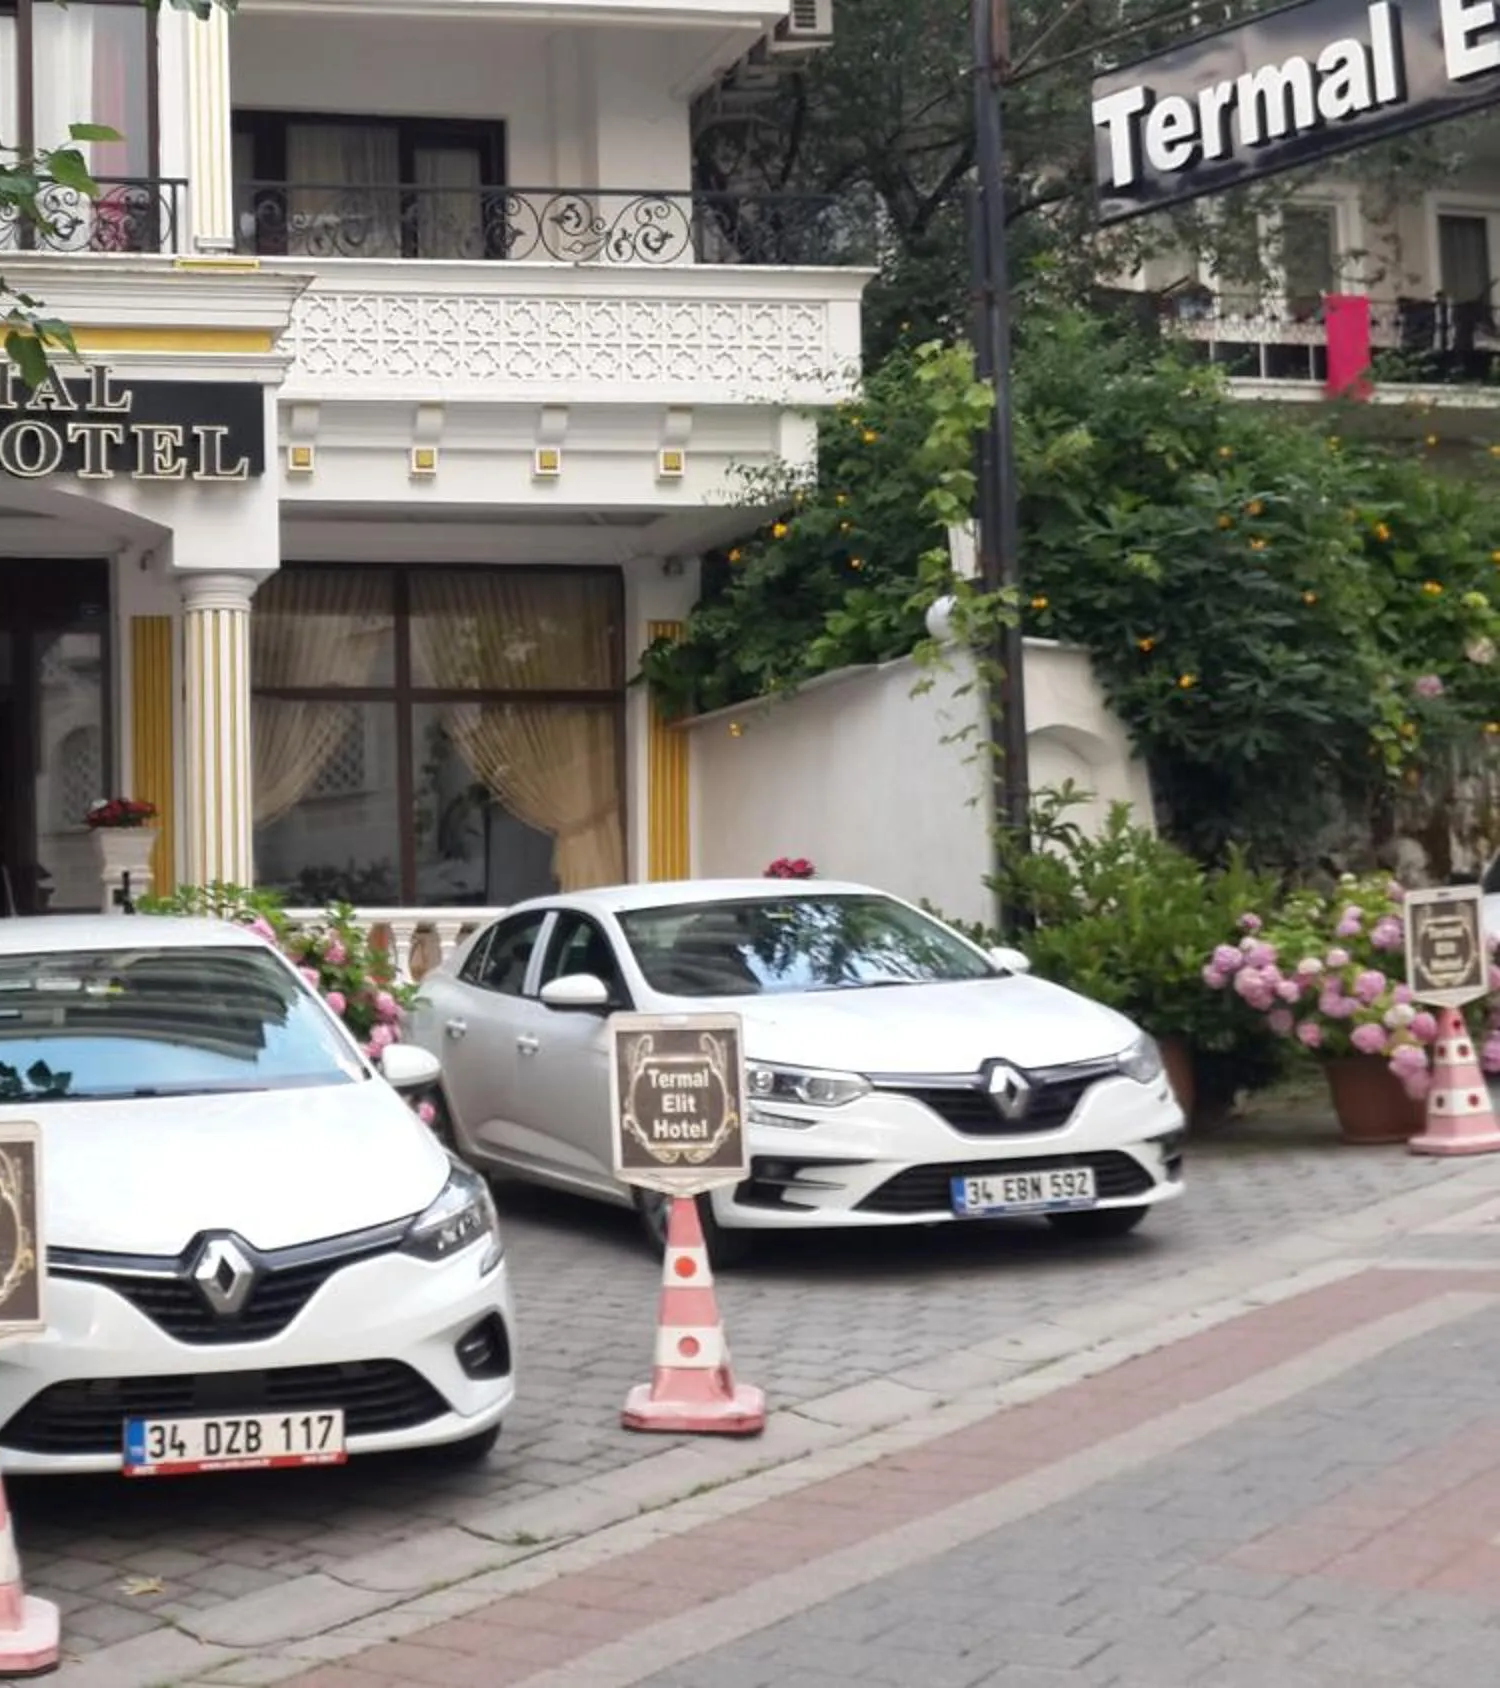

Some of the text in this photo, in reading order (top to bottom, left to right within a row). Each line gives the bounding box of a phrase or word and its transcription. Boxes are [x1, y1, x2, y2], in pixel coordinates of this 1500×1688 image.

[1093, 2, 1399, 188] Termal
[647, 1069, 709, 1088] Termal
[662, 1093, 697, 1113] Elit
[653, 1119, 707, 1138] Hotel
[968, 1181, 994, 1205] 34
[1050, 1172, 1088, 1198] 592
[149, 1415, 334, 1458] 34 DZB 117
